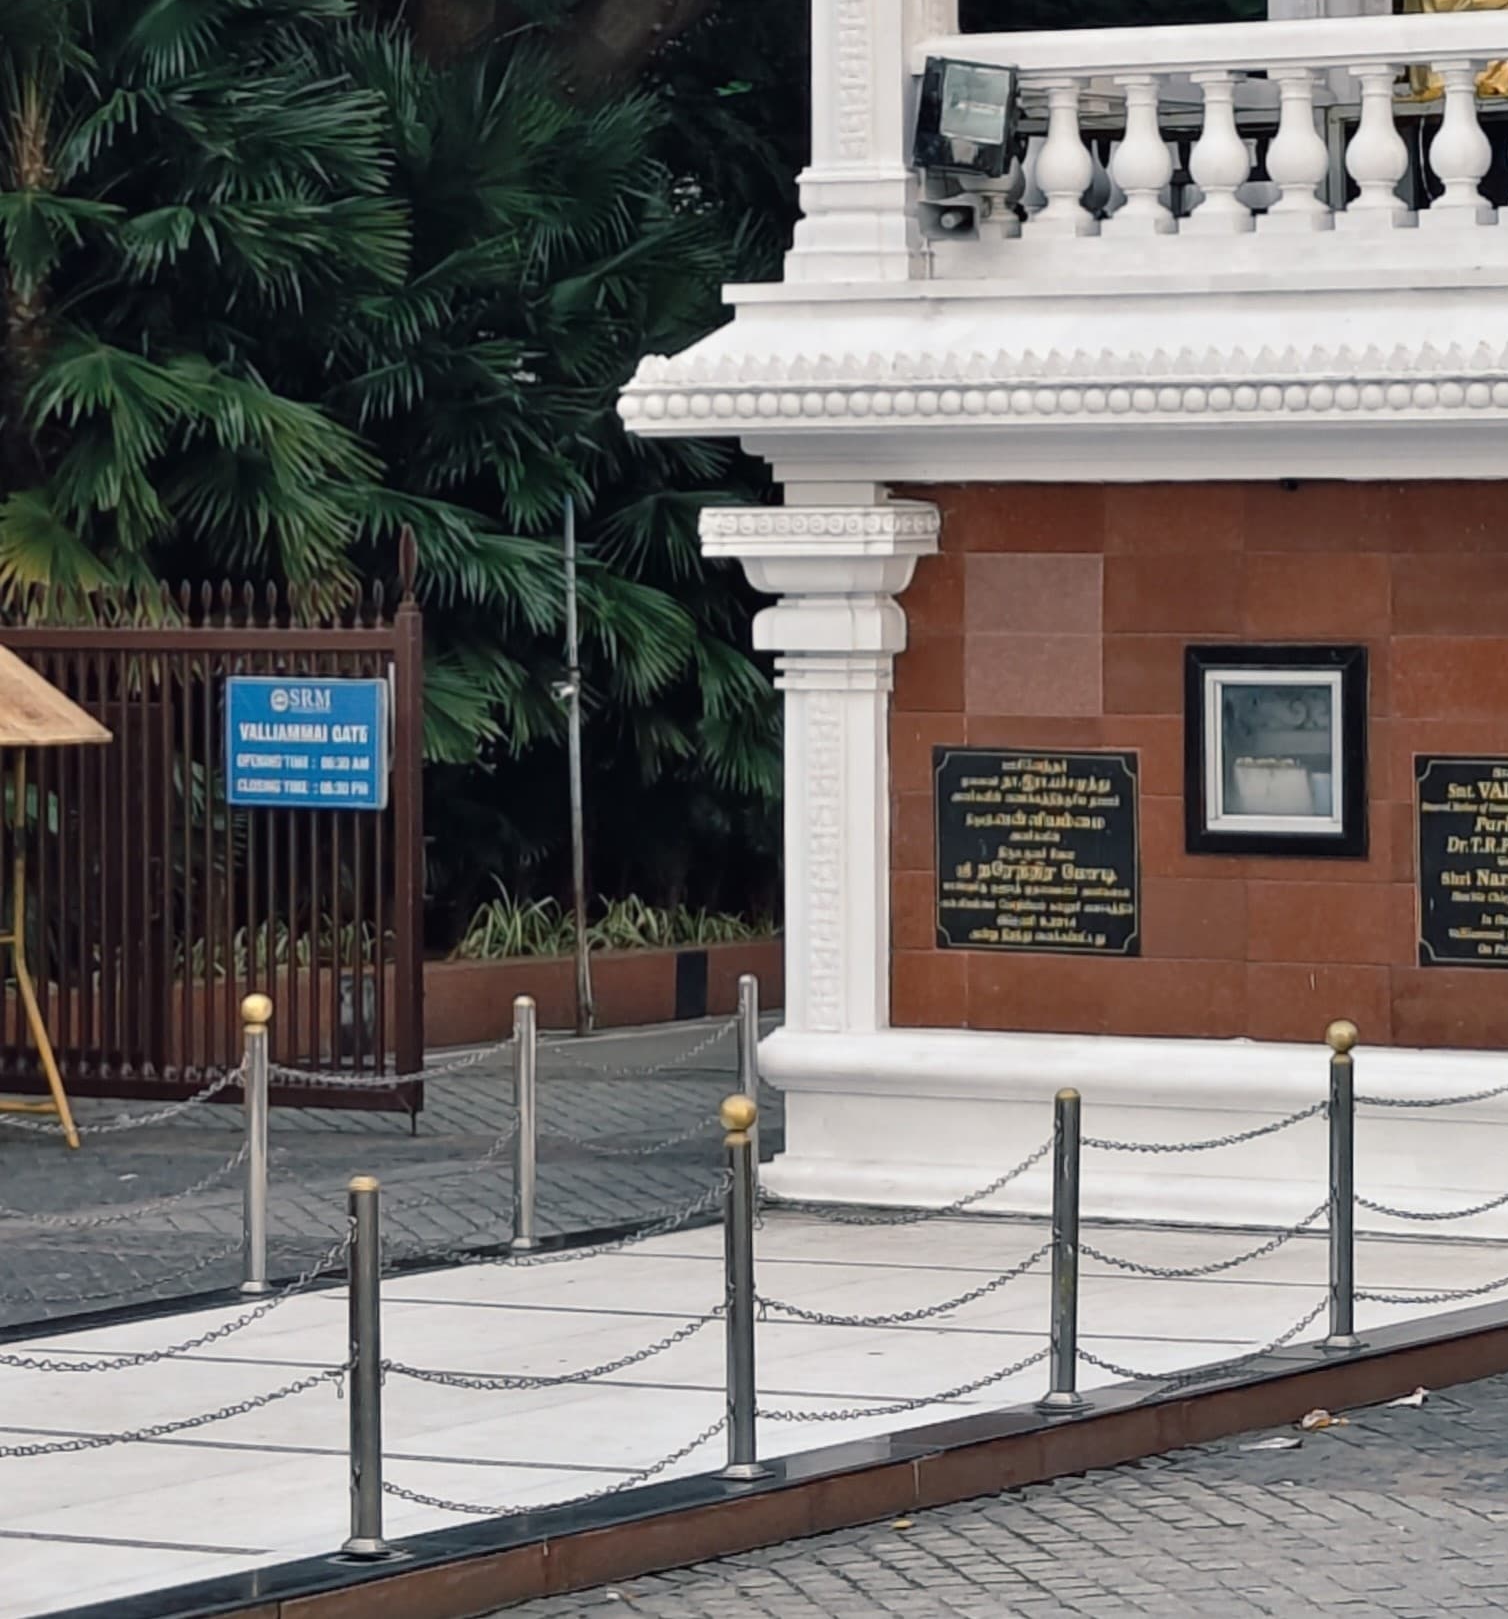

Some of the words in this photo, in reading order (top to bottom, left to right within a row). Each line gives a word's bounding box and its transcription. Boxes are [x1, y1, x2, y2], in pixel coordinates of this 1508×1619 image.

[290, 688, 331, 709] SRM
[239, 722, 328, 743] VALLIAMMAI
[332, 725, 368, 743] GATE
